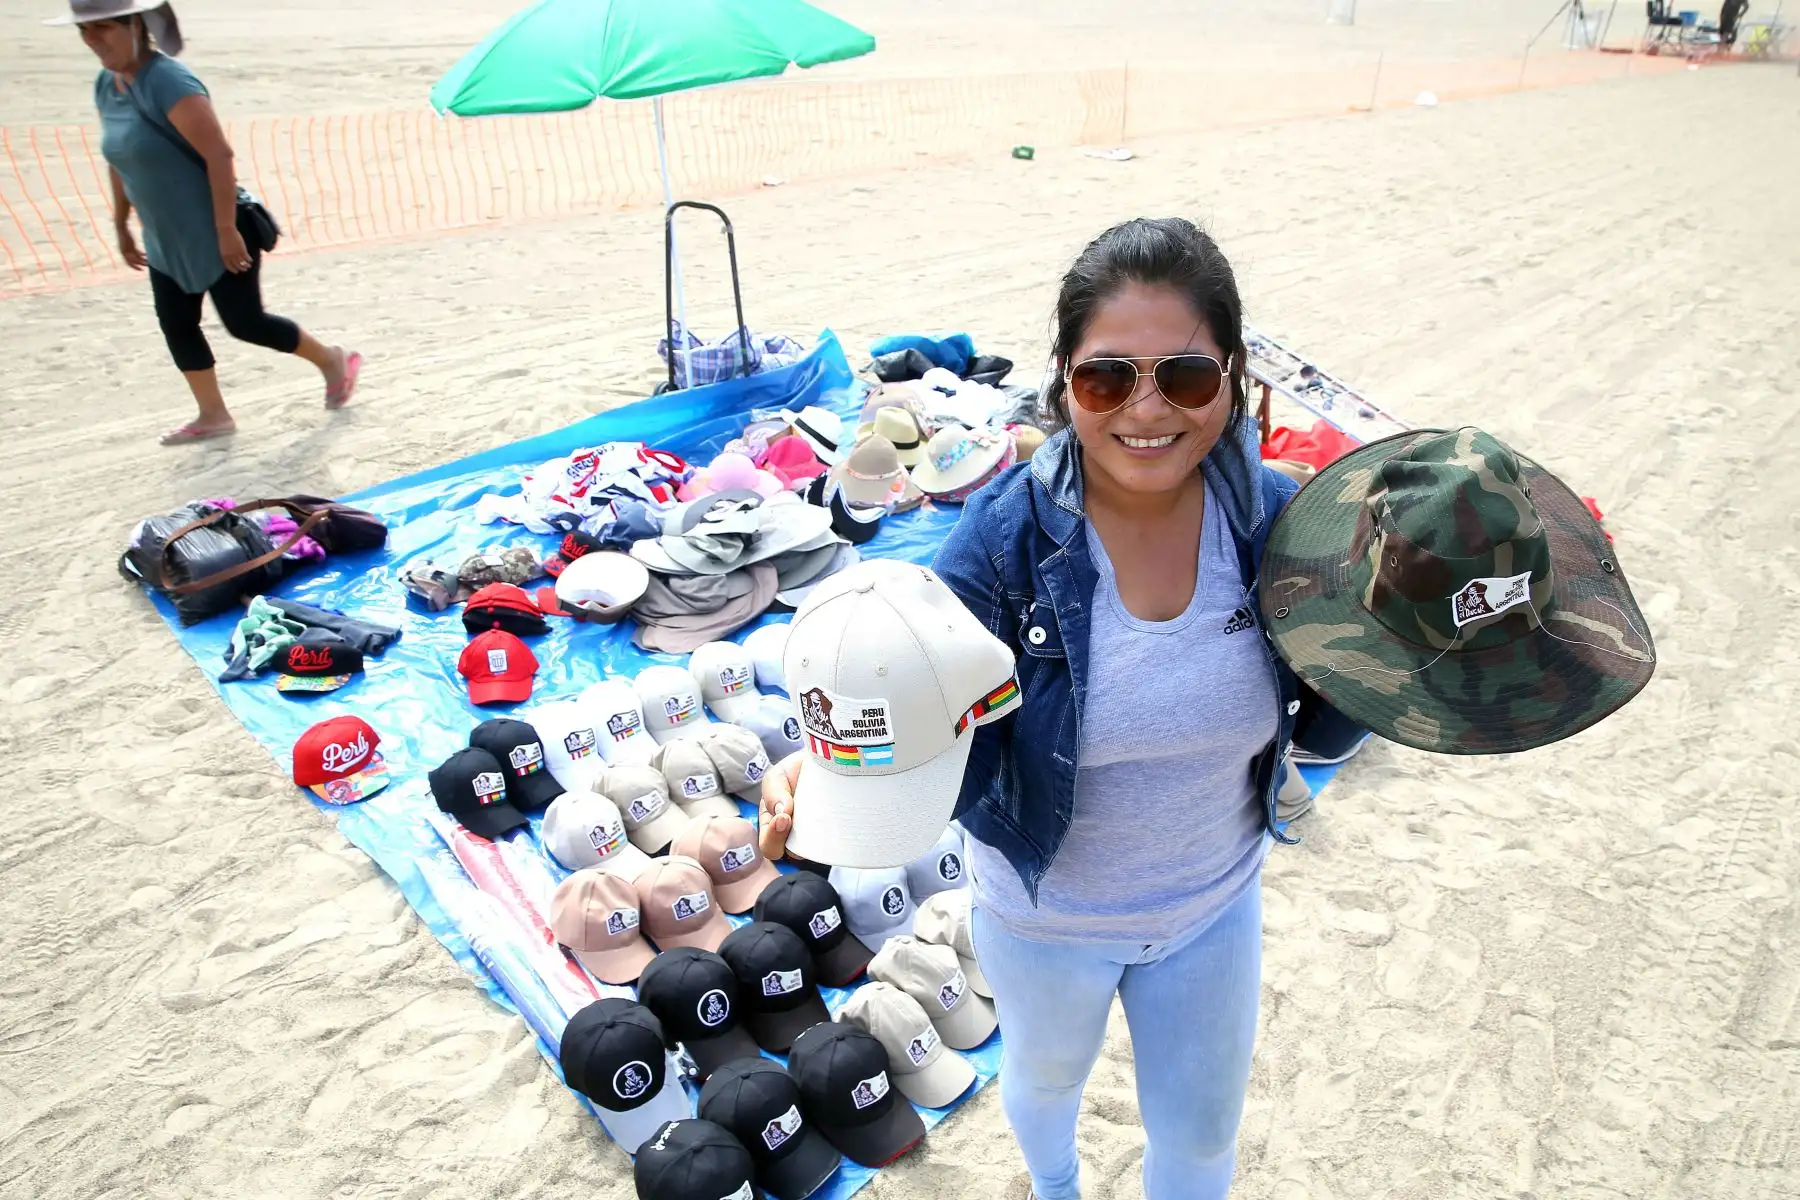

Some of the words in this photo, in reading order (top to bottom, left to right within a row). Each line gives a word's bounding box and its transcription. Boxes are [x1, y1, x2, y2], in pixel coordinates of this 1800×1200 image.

[861, 707, 884, 719] PERU
[852, 717, 886, 729] BOLIVIA
[840, 727, 888, 738] ARGENTINA
[322, 731, 369, 772] Perú
